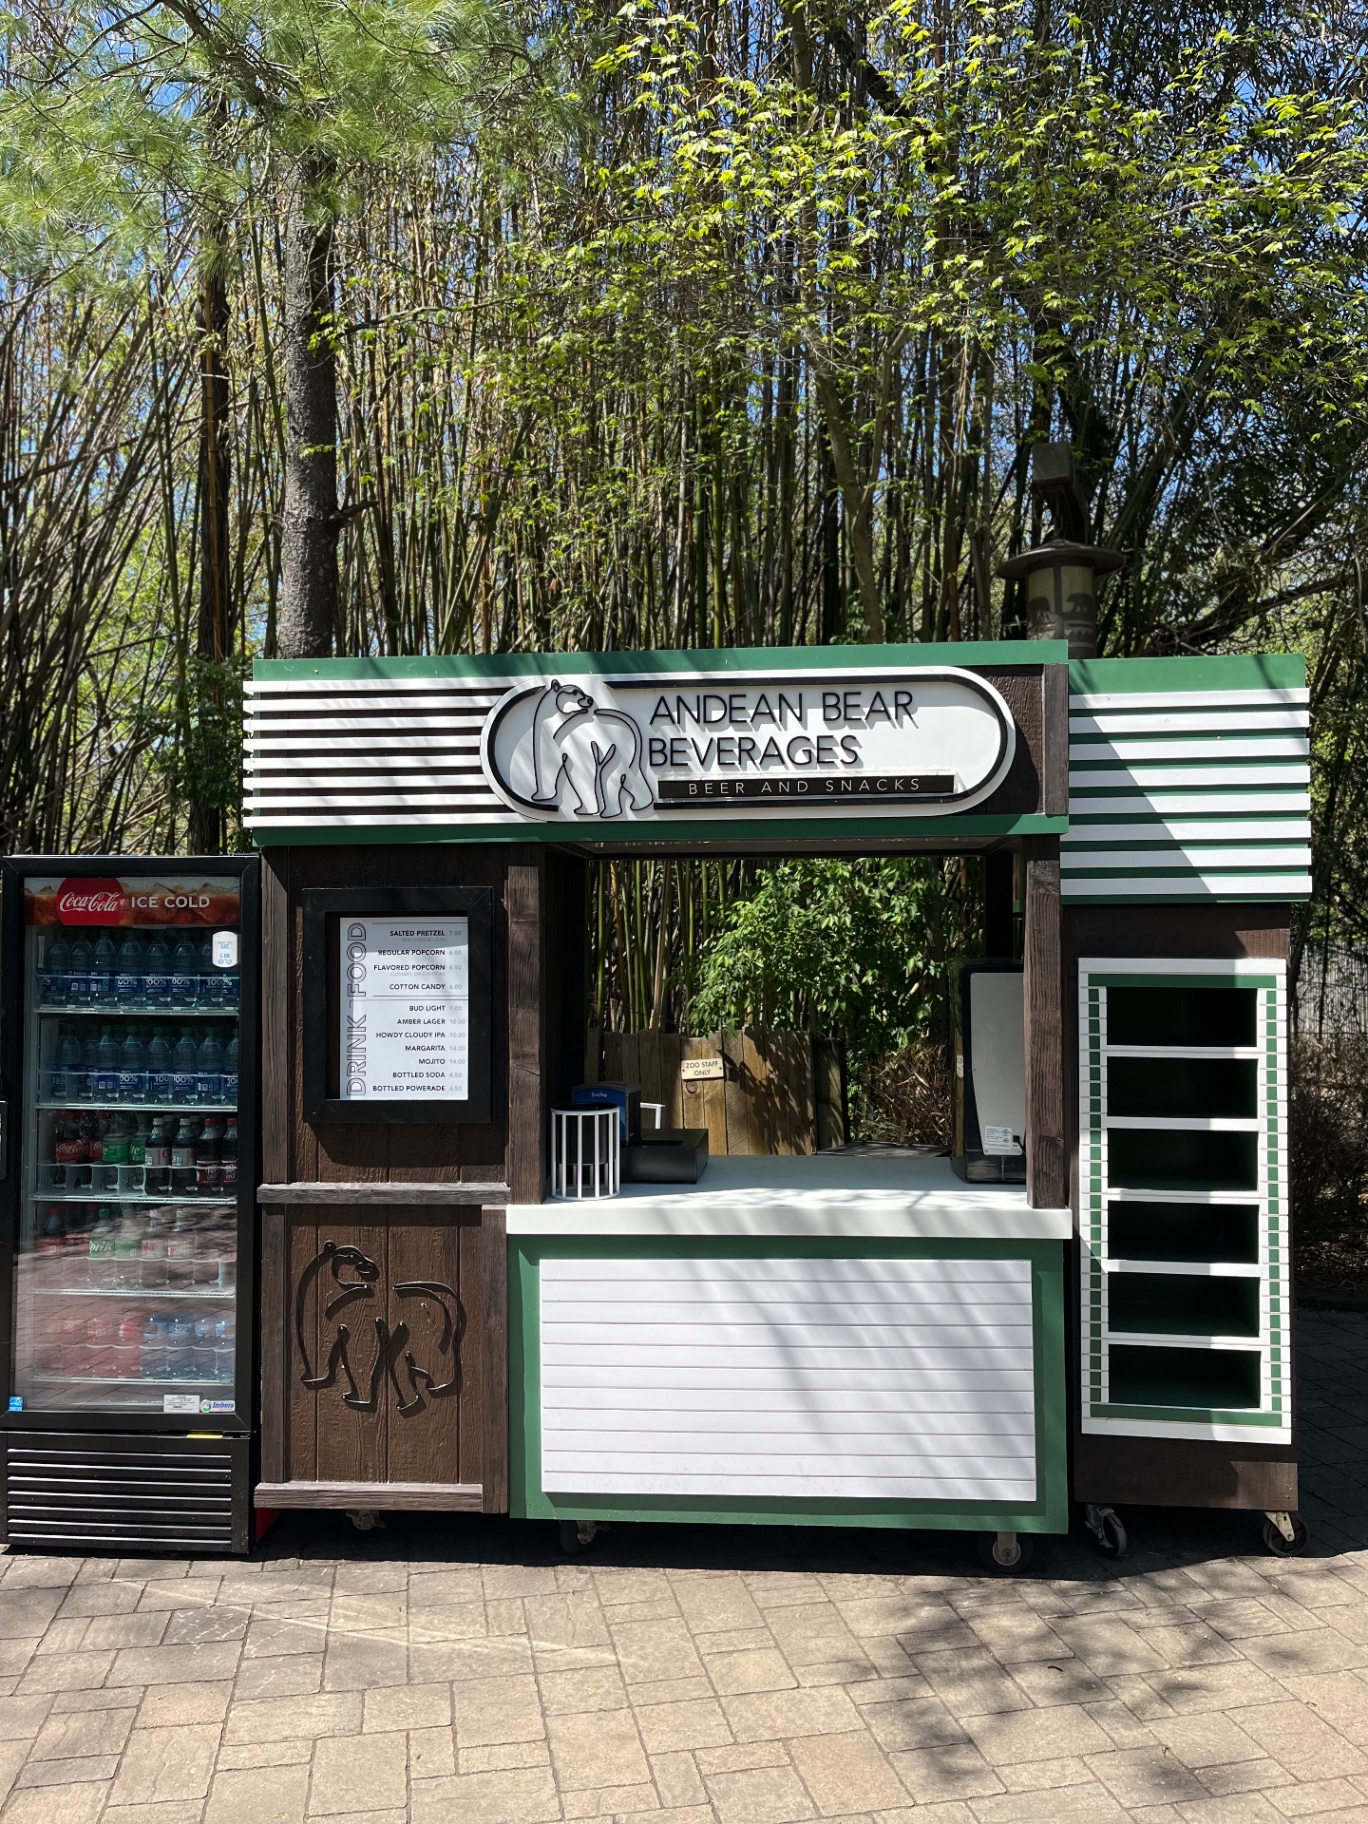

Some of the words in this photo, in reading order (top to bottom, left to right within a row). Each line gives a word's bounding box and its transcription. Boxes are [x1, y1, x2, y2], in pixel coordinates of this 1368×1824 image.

[650, 692, 803, 725] ANDEAN
[822, 690, 915, 722] BEAR
[648, 734, 859, 767] BEVERAGES
[688, 782, 745, 795] BEER
[761, 780, 809, 794] AND
[825, 778, 919, 792] SNACKS
[59, 891, 121, 912] Coca-Cola
[131, 896, 158, 908] ICE
[164, 896, 210, 908] COLD
[347, 922, 367, 998] FOOD
[346, 1014, 367, 1096] DRINK
[694, 1069, 711, 1077] ONLY
